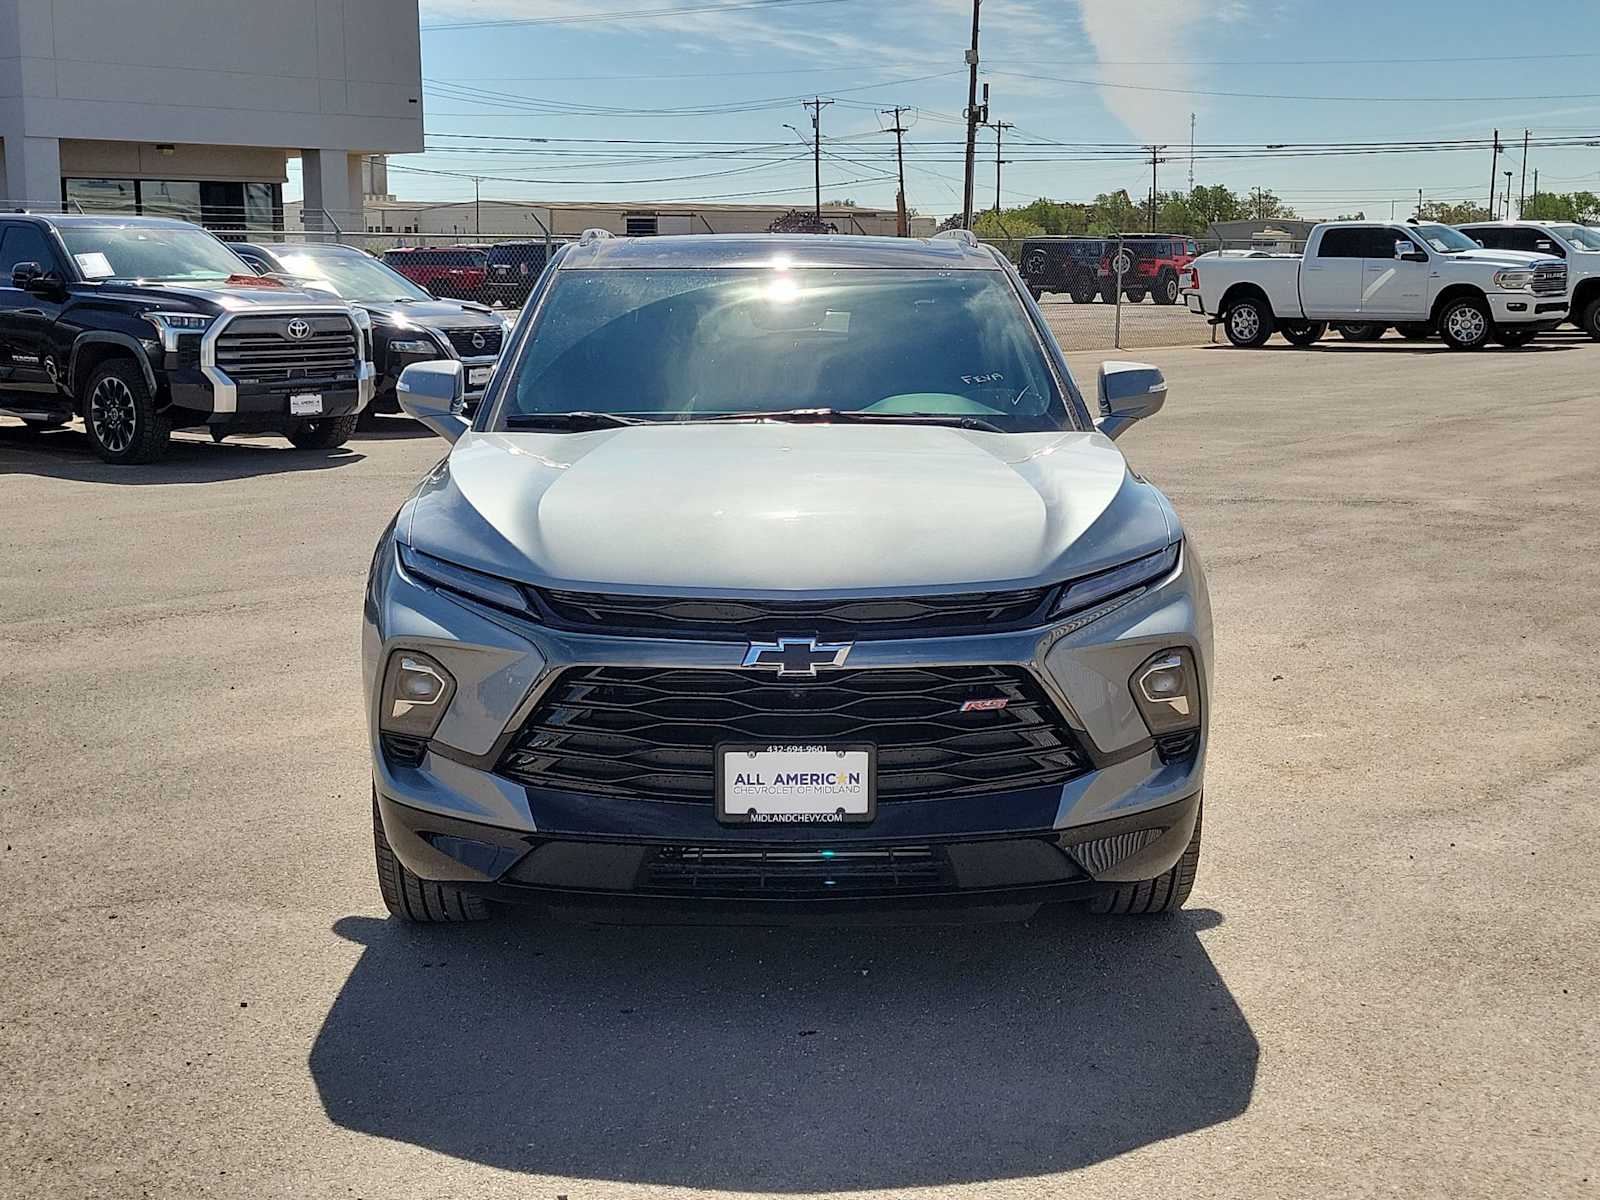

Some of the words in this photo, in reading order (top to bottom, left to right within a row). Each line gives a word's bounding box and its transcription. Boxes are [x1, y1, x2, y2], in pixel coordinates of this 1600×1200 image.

[960, 699, 1008, 711] RS
[734, 773, 765, 785] ALL
[734, 786, 793, 795] CHEVROLET
[797, 786, 811, 795] OF
[814, 785, 861, 794] MIDLAND
[750, 813, 843, 823] MIDLANDCHEVY.COM
